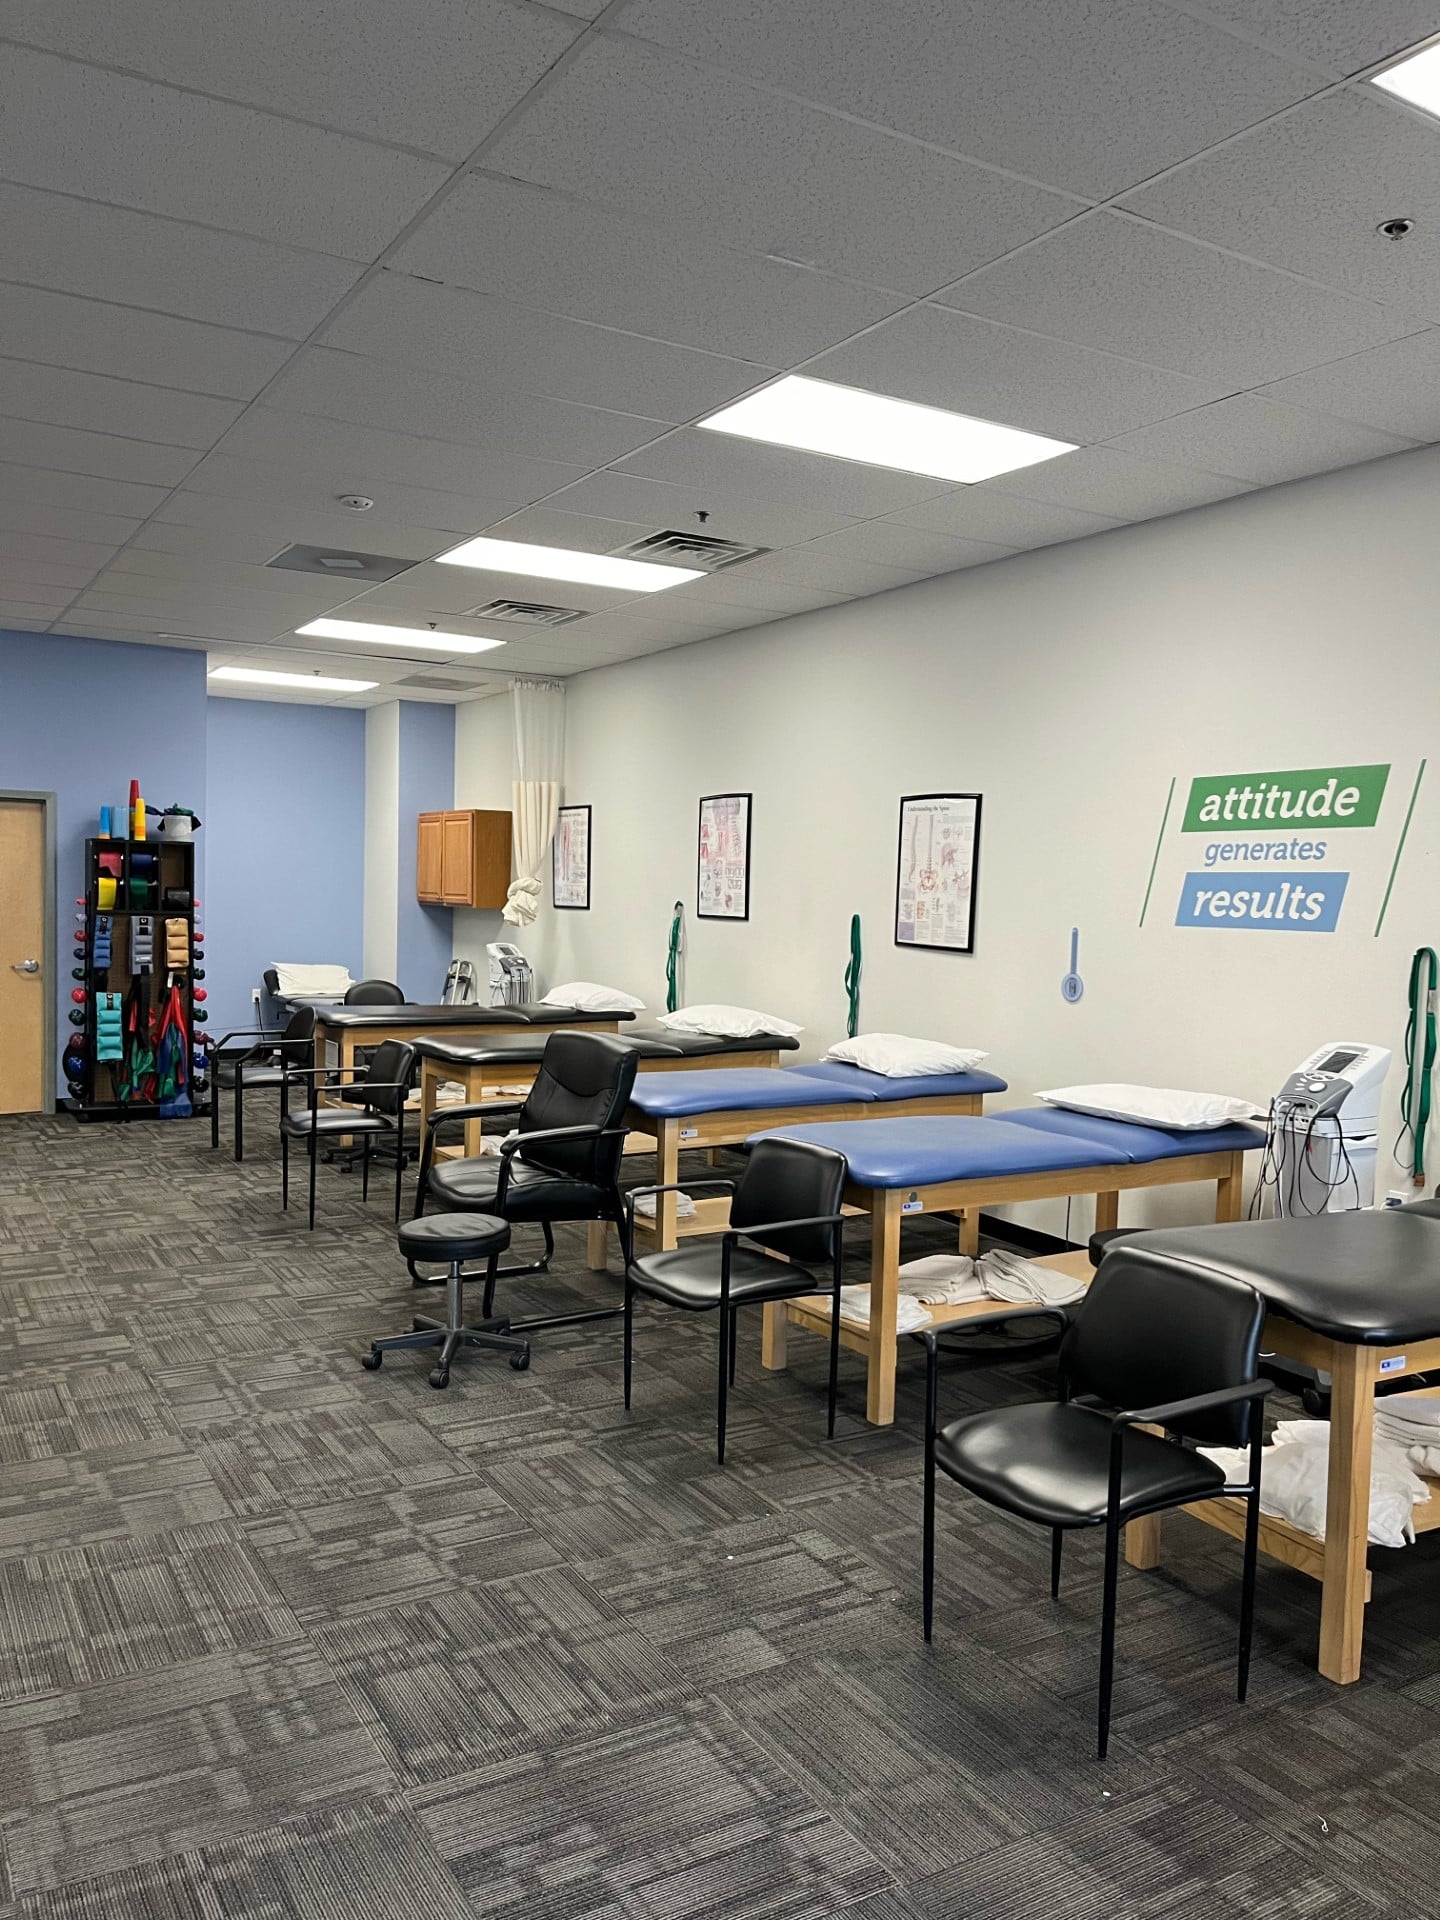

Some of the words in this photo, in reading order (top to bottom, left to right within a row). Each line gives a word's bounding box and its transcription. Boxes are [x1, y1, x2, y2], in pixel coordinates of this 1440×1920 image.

[1198, 778, 1361, 822] attitude
[1203, 837, 1328, 867] generates
[1192, 882, 1326, 921] results
